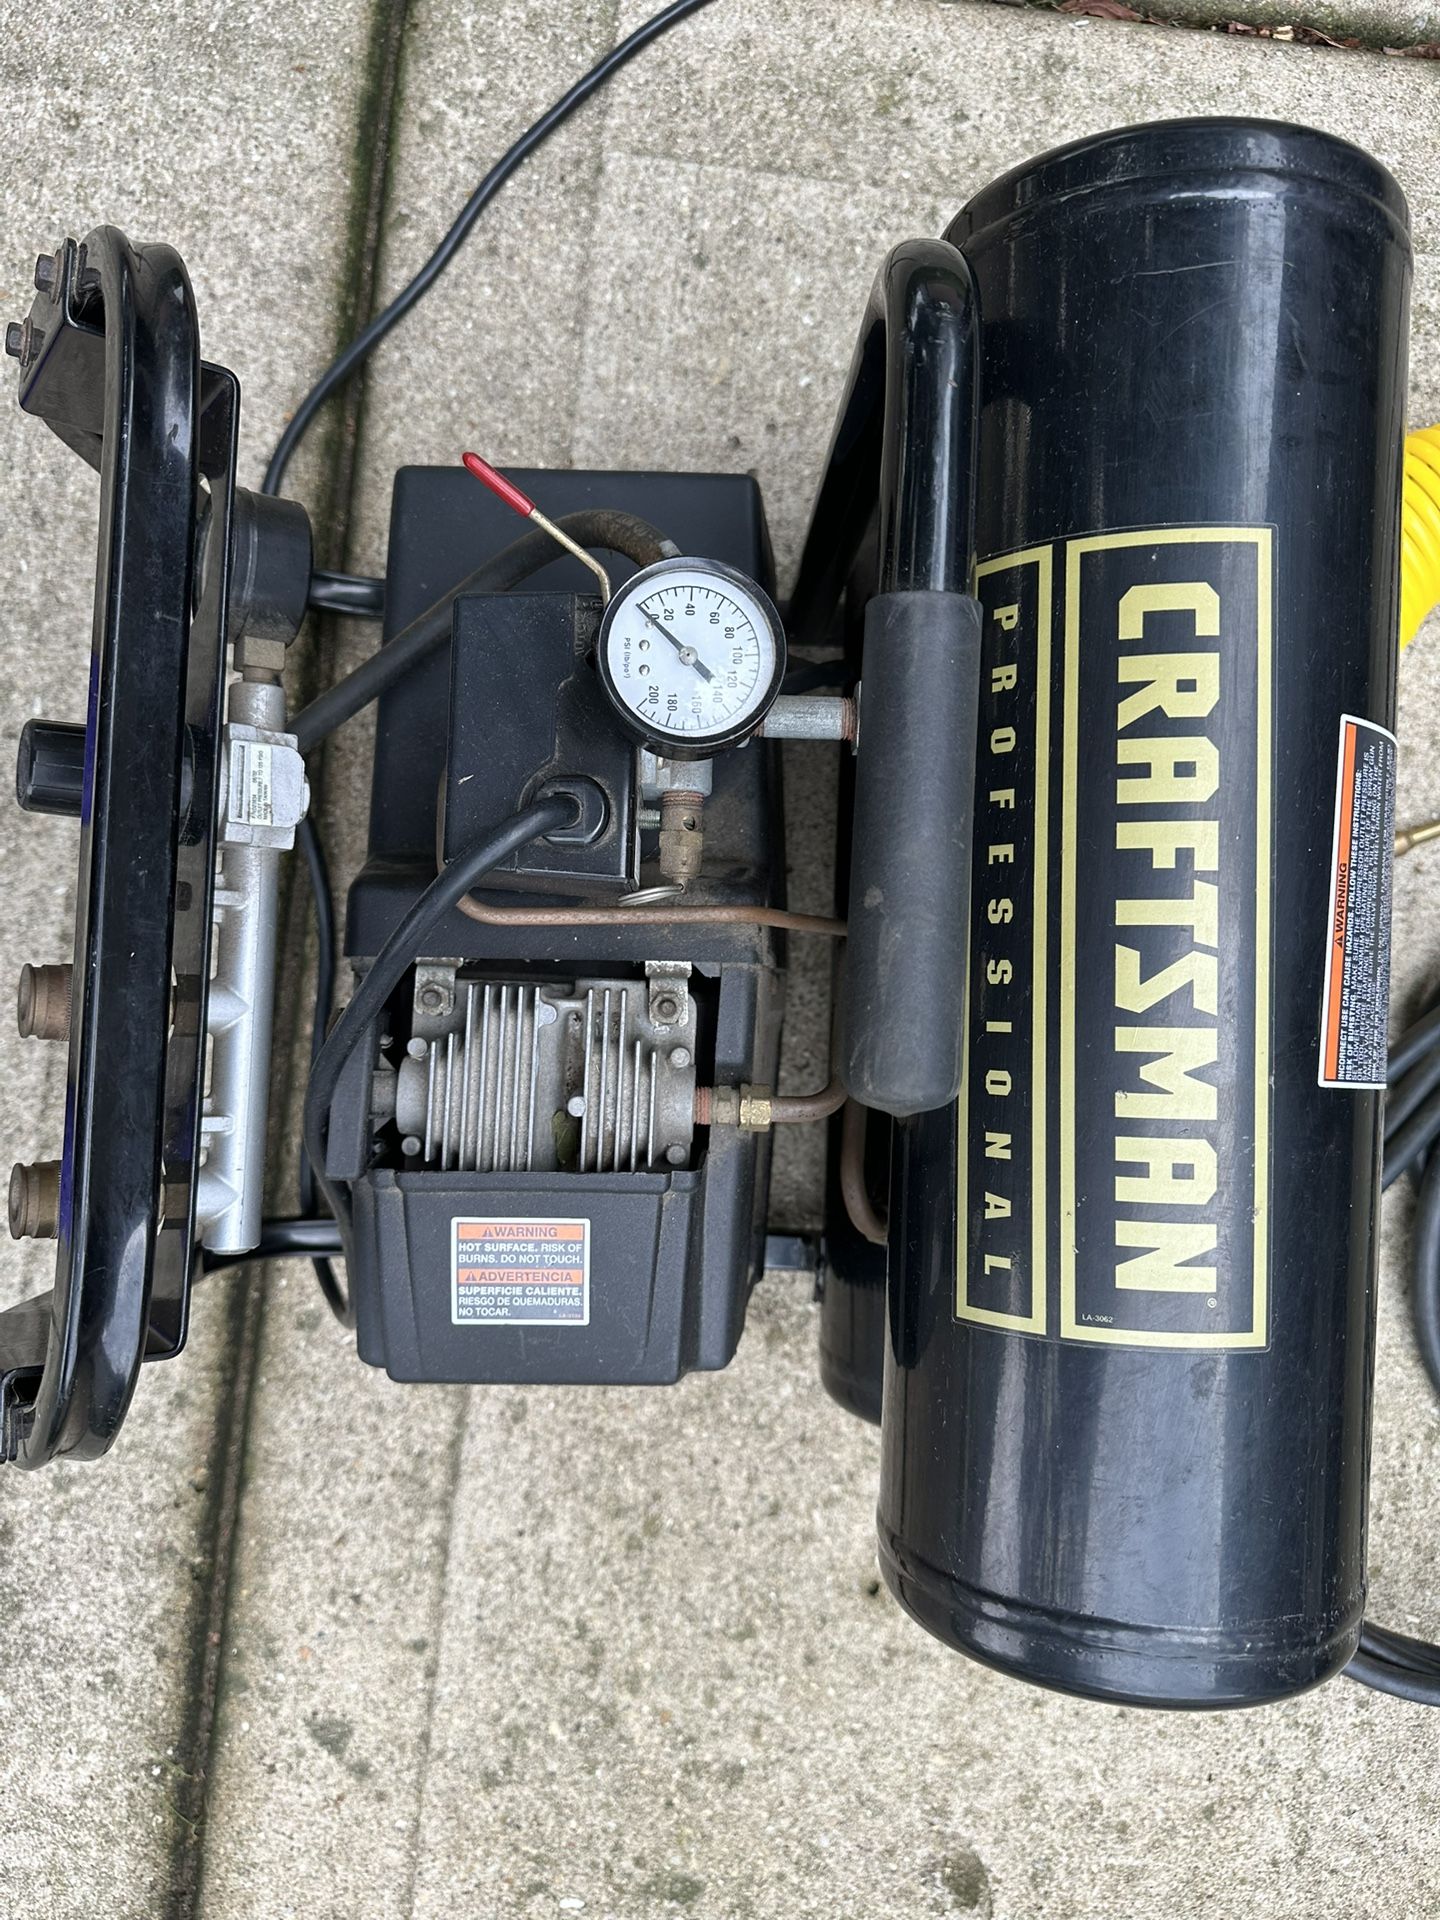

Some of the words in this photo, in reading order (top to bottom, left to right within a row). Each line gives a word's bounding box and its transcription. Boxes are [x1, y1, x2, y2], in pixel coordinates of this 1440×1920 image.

[664, 609, 673, 621] 20
[685, 603, 695, 616] 40
[709, 611, 719, 624] 60
[724, 626, 734, 640] 80
[732, 646, 742, 665] 100
[727, 670, 737, 688] 120
[648, 685, 659, 705] 200
[667, 693, 677, 711] 180
[712, 685, 723, 704] 140
[691, 695, 702, 714] 160
[1350, 840, 1359, 867] THESE
[1348, 870, 1356, 907] FOLLOW
[1335, 863, 1347, 933] WARNING
[984, 604, 1018, 1277] PROFESSIONAL
[1114, 581, 1221, 1293] CRAFTSMAN
[1343, 956, 1352, 986] CAUSE
[1342, 988, 1350, 1006] CAN
[1340, 1009, 1349, 1028] USE
[1338, 1029, 1348, 1080] INCORRECT
[494, 1226, 558, 1238] WARNING
[458, 1243, 482, 1252] HOT
[484, 1243, 538, 1252] SURFACE.
[541, 1243, 565, 1252] RISK
[567, 1244, 582, 1253] OF
[458, 1255, 498, 1264] BURNS.
[500, 1255, 517, 1263] DO
[519, 1255, 540, 1263] NOT
[544, 1255, 583, 1264] TOUCH.
[478, 1272, 573, 1282] ADVERTENCIA
[458, 1287, 523, 1295] SUPERFICIE
[525, 1287, 582, 1296] CALIENTE.
[458, 1297, 495, 1306] RIESGO
[497, 1297, 510, 1306] DE
[512, 1297, 583, 1306] QUEMADURAS.
[458, 1308, 473, 1316] NO
[475, 1307, 511, 1316] TOCAR.
[1081, 1313, 1114, 1324] LA-3062
